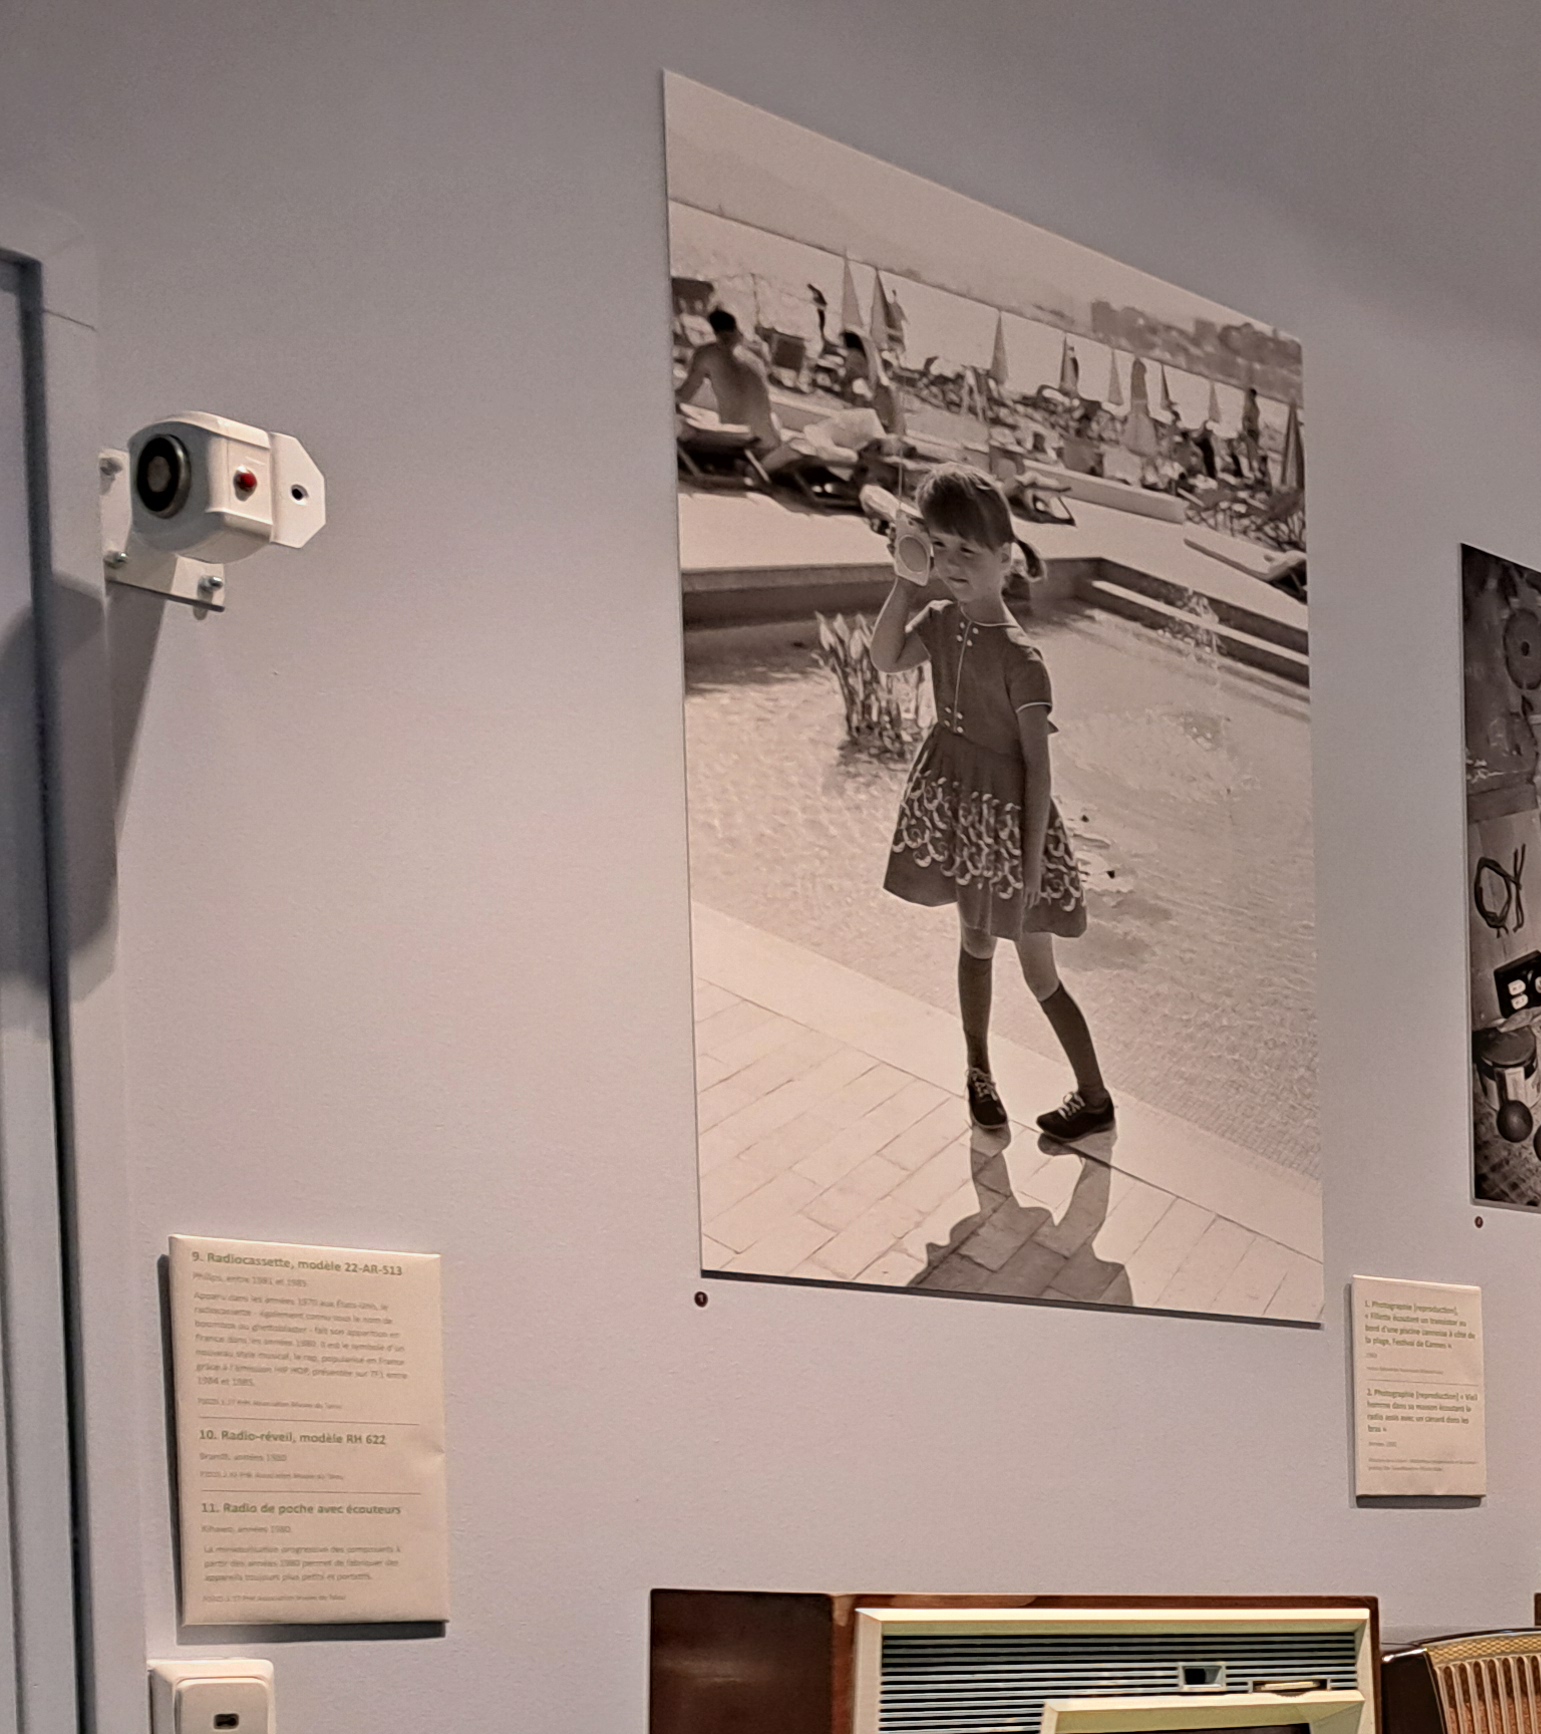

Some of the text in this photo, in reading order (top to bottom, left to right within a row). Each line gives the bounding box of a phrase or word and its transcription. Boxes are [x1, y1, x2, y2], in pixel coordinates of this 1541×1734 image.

[207, 1252, 294, 1270] Radiocassette,
[298, 1261, 341, 1271] modèle
[345, 1262, 402, 1276] 22-AR-513
[199, 1429, 386, 1445] 10. Radio-réveil, modèle RH 622
[202, 1503, 219, 1512] 11.
[223, 1503, 257, 1513] Radio
[261, 1504, 275, 1513] de
[278, 1504, 314, 1515] poche
[346, 1505, 401, 1514] écouteurs
